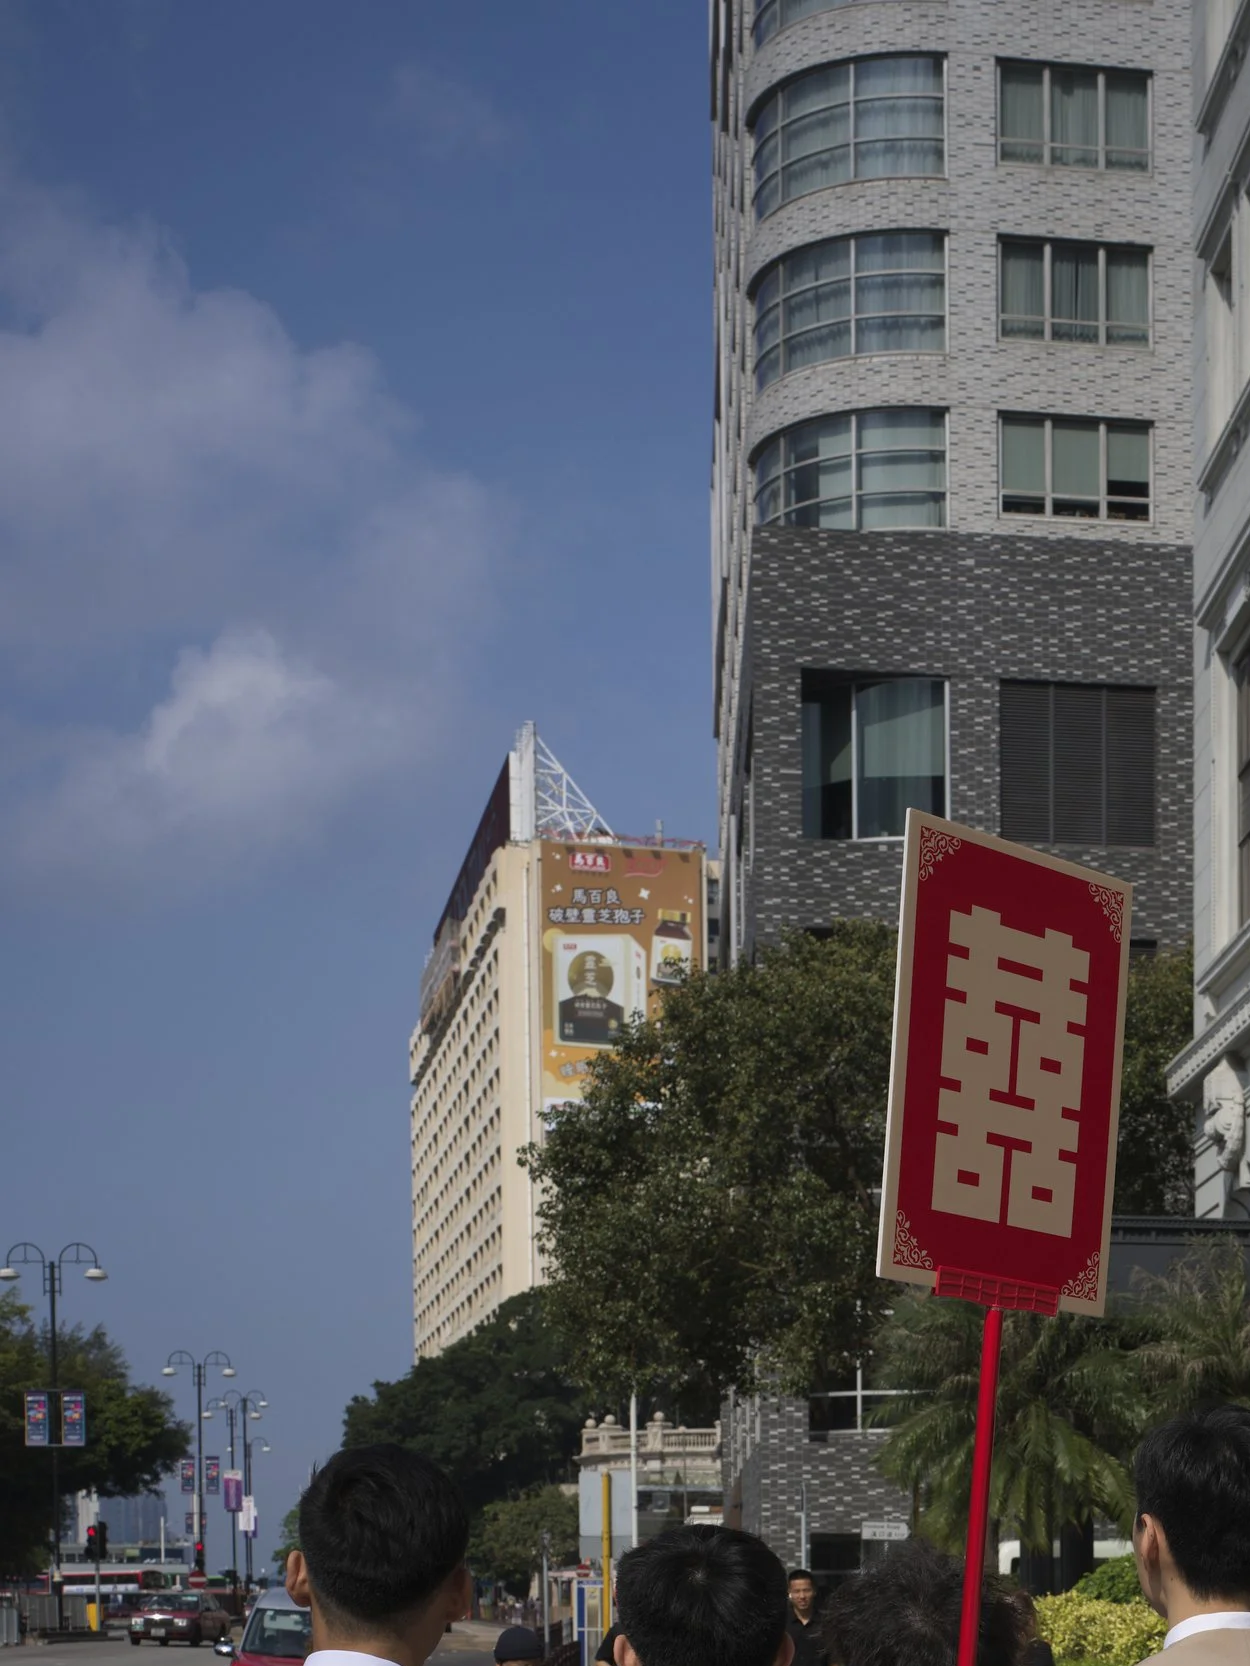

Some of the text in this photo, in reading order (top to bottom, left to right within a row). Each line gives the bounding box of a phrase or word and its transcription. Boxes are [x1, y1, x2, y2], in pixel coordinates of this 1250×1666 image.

[572, 888, 621, 905] 馬百良
[549, 908, 645, 924] 破壁靈芝孢子
